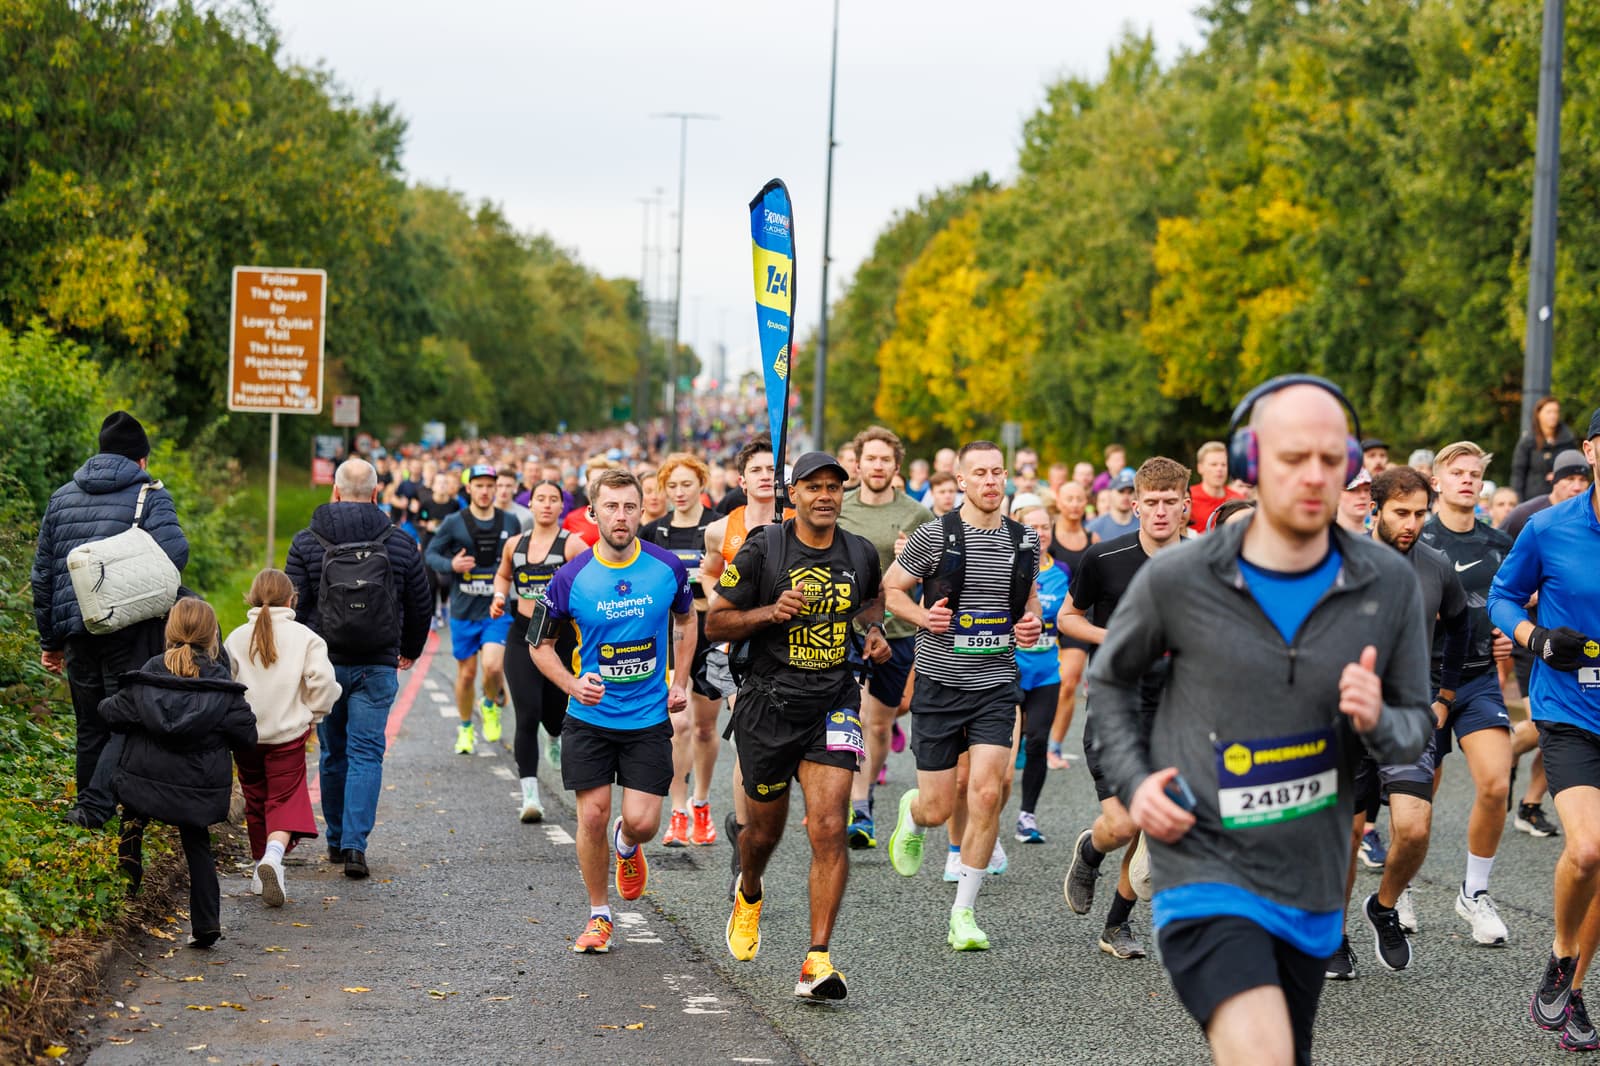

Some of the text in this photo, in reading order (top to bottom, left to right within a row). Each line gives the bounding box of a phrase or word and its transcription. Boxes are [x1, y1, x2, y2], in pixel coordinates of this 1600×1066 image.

[261, 272, 298, 287] Follow
[250, 286, 308, 303] The Quays
[269, 302, 287, 315] for
[242, 316, 314, 331] Lowry Outlet
[265, 328, 290, 340] Mall
[249, 341, 305, 357] The Lowry
[244, 356, 309, 370] Manchester
[241, 381, 286, 395] Imperial
[235, 393, 281, 406] Museum
[596, 594, 653, 612] Alzheimer's
[605, 607, 645, 620] Society
[833, 583, 851, 647] PAER
[616, 642, 652, 653] #MCRHALF
[968, 636, 1000, 647] 5994
[789, 645, 845, 661] ERDINGER
[609, 662, 649, 676] 17676
[1253, 739, 1327, 765] #MCRHALF
[1240, 780, 1321, 810] 24879
